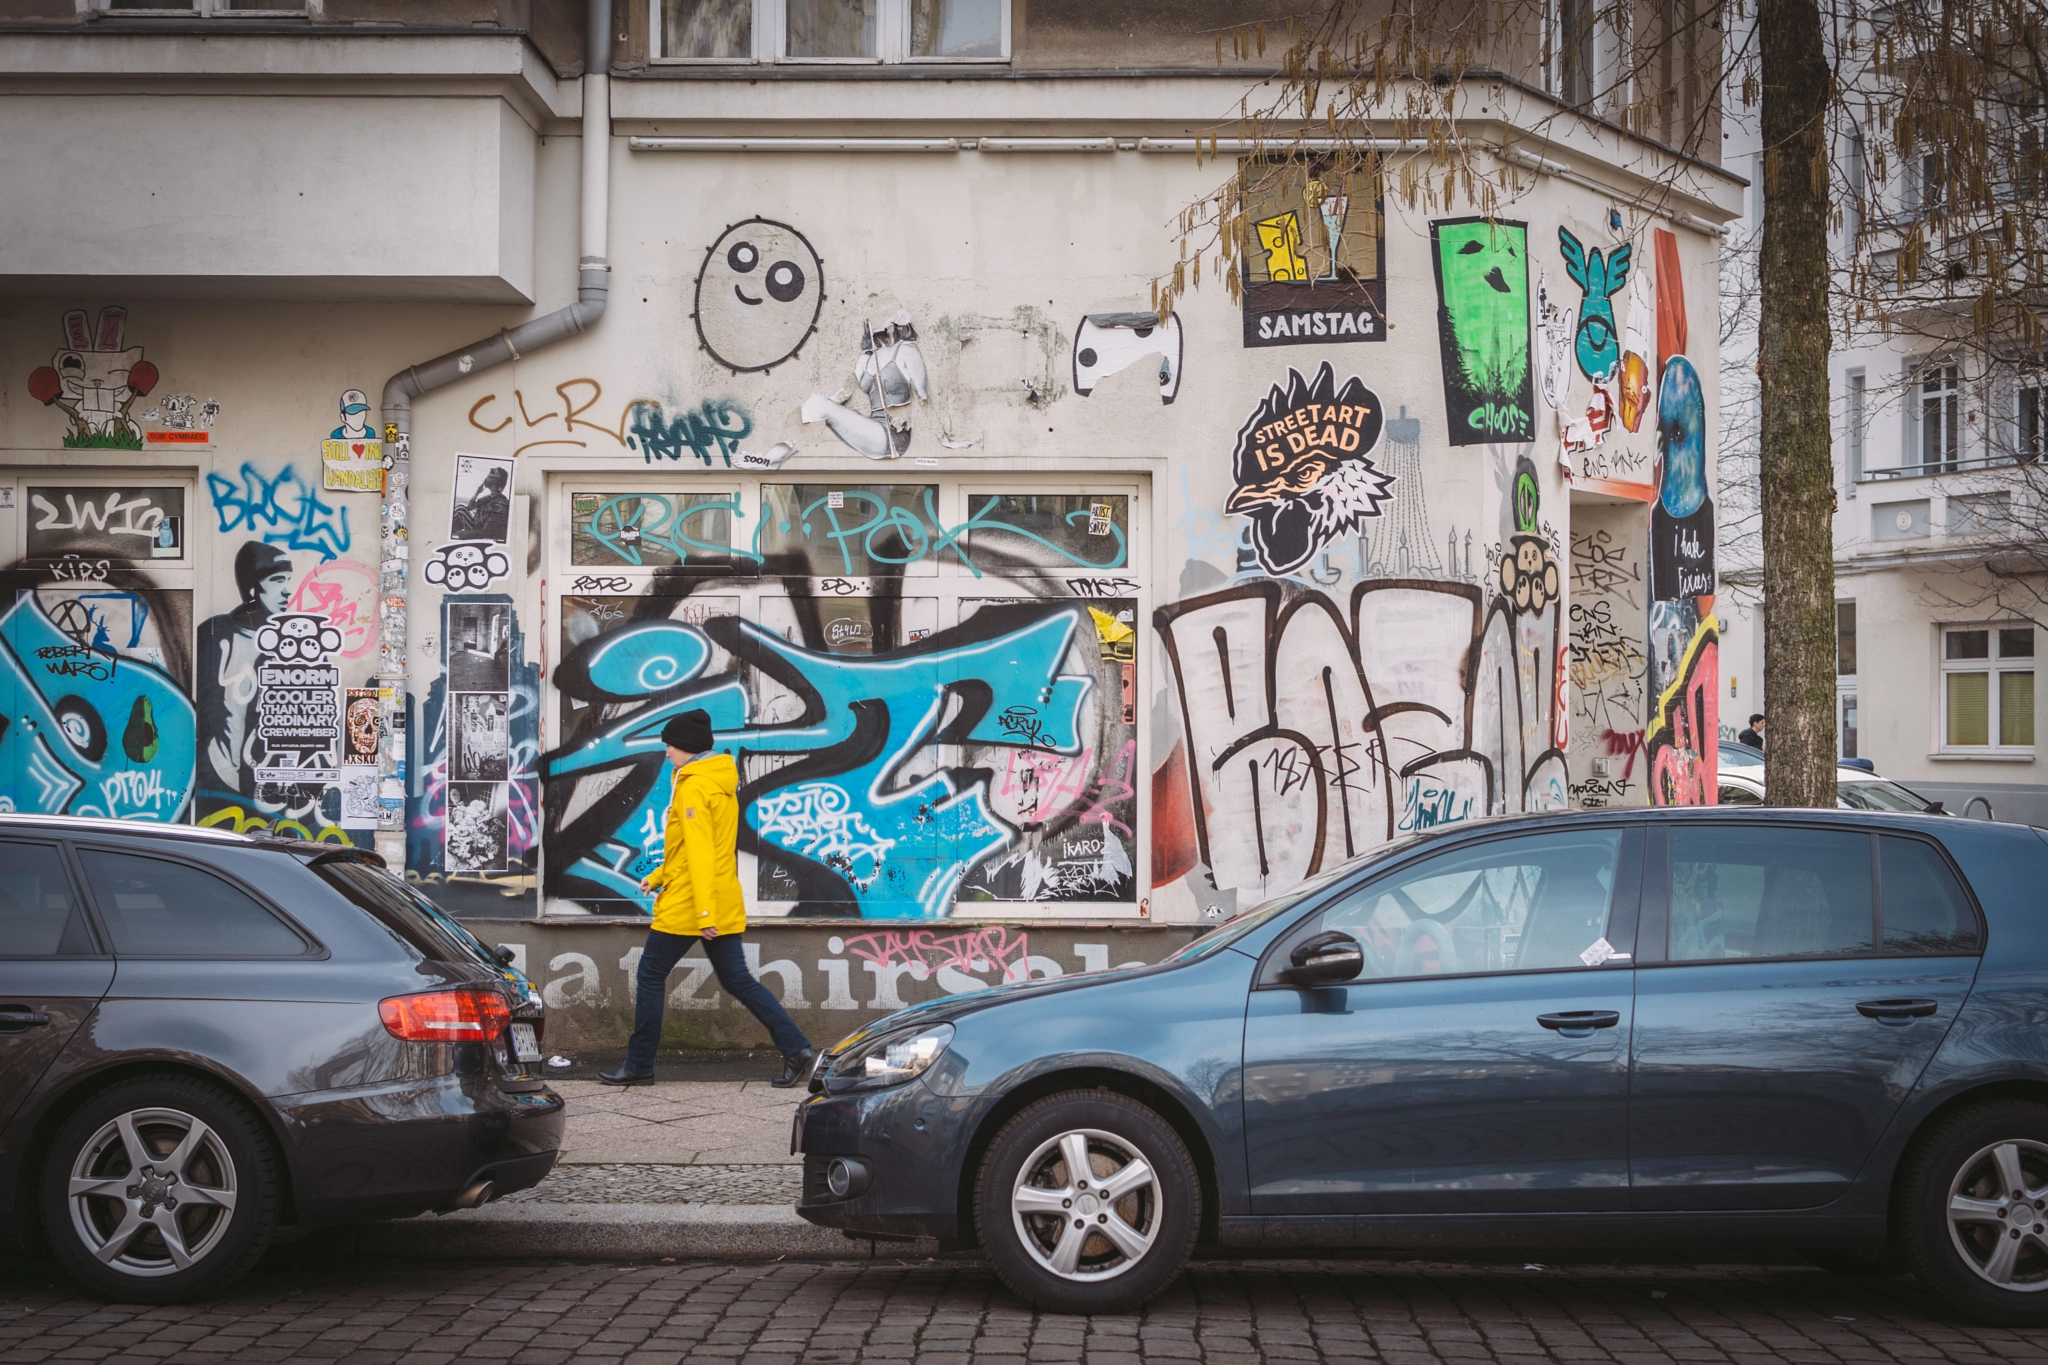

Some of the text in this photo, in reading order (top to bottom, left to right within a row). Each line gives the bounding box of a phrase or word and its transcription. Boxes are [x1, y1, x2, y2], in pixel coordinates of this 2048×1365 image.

[1258, 311, 1374, 339] SAMSTAG
[322, 441, 350, 461] STILL
[1254, 424, 1360, 472] IS DEAD
[1681, 528, 1705, 559] hate
[49, 560, 110, 580] KIDS
[261, 669, 338, 685] ENORM
[264, 690, 334, 705] COOLER
[263, 704, 335, 715] THAN YOUR
[263, 714, 336, 726] ORDINARY
[261, 727, 337, 737] CREWMEMBER
